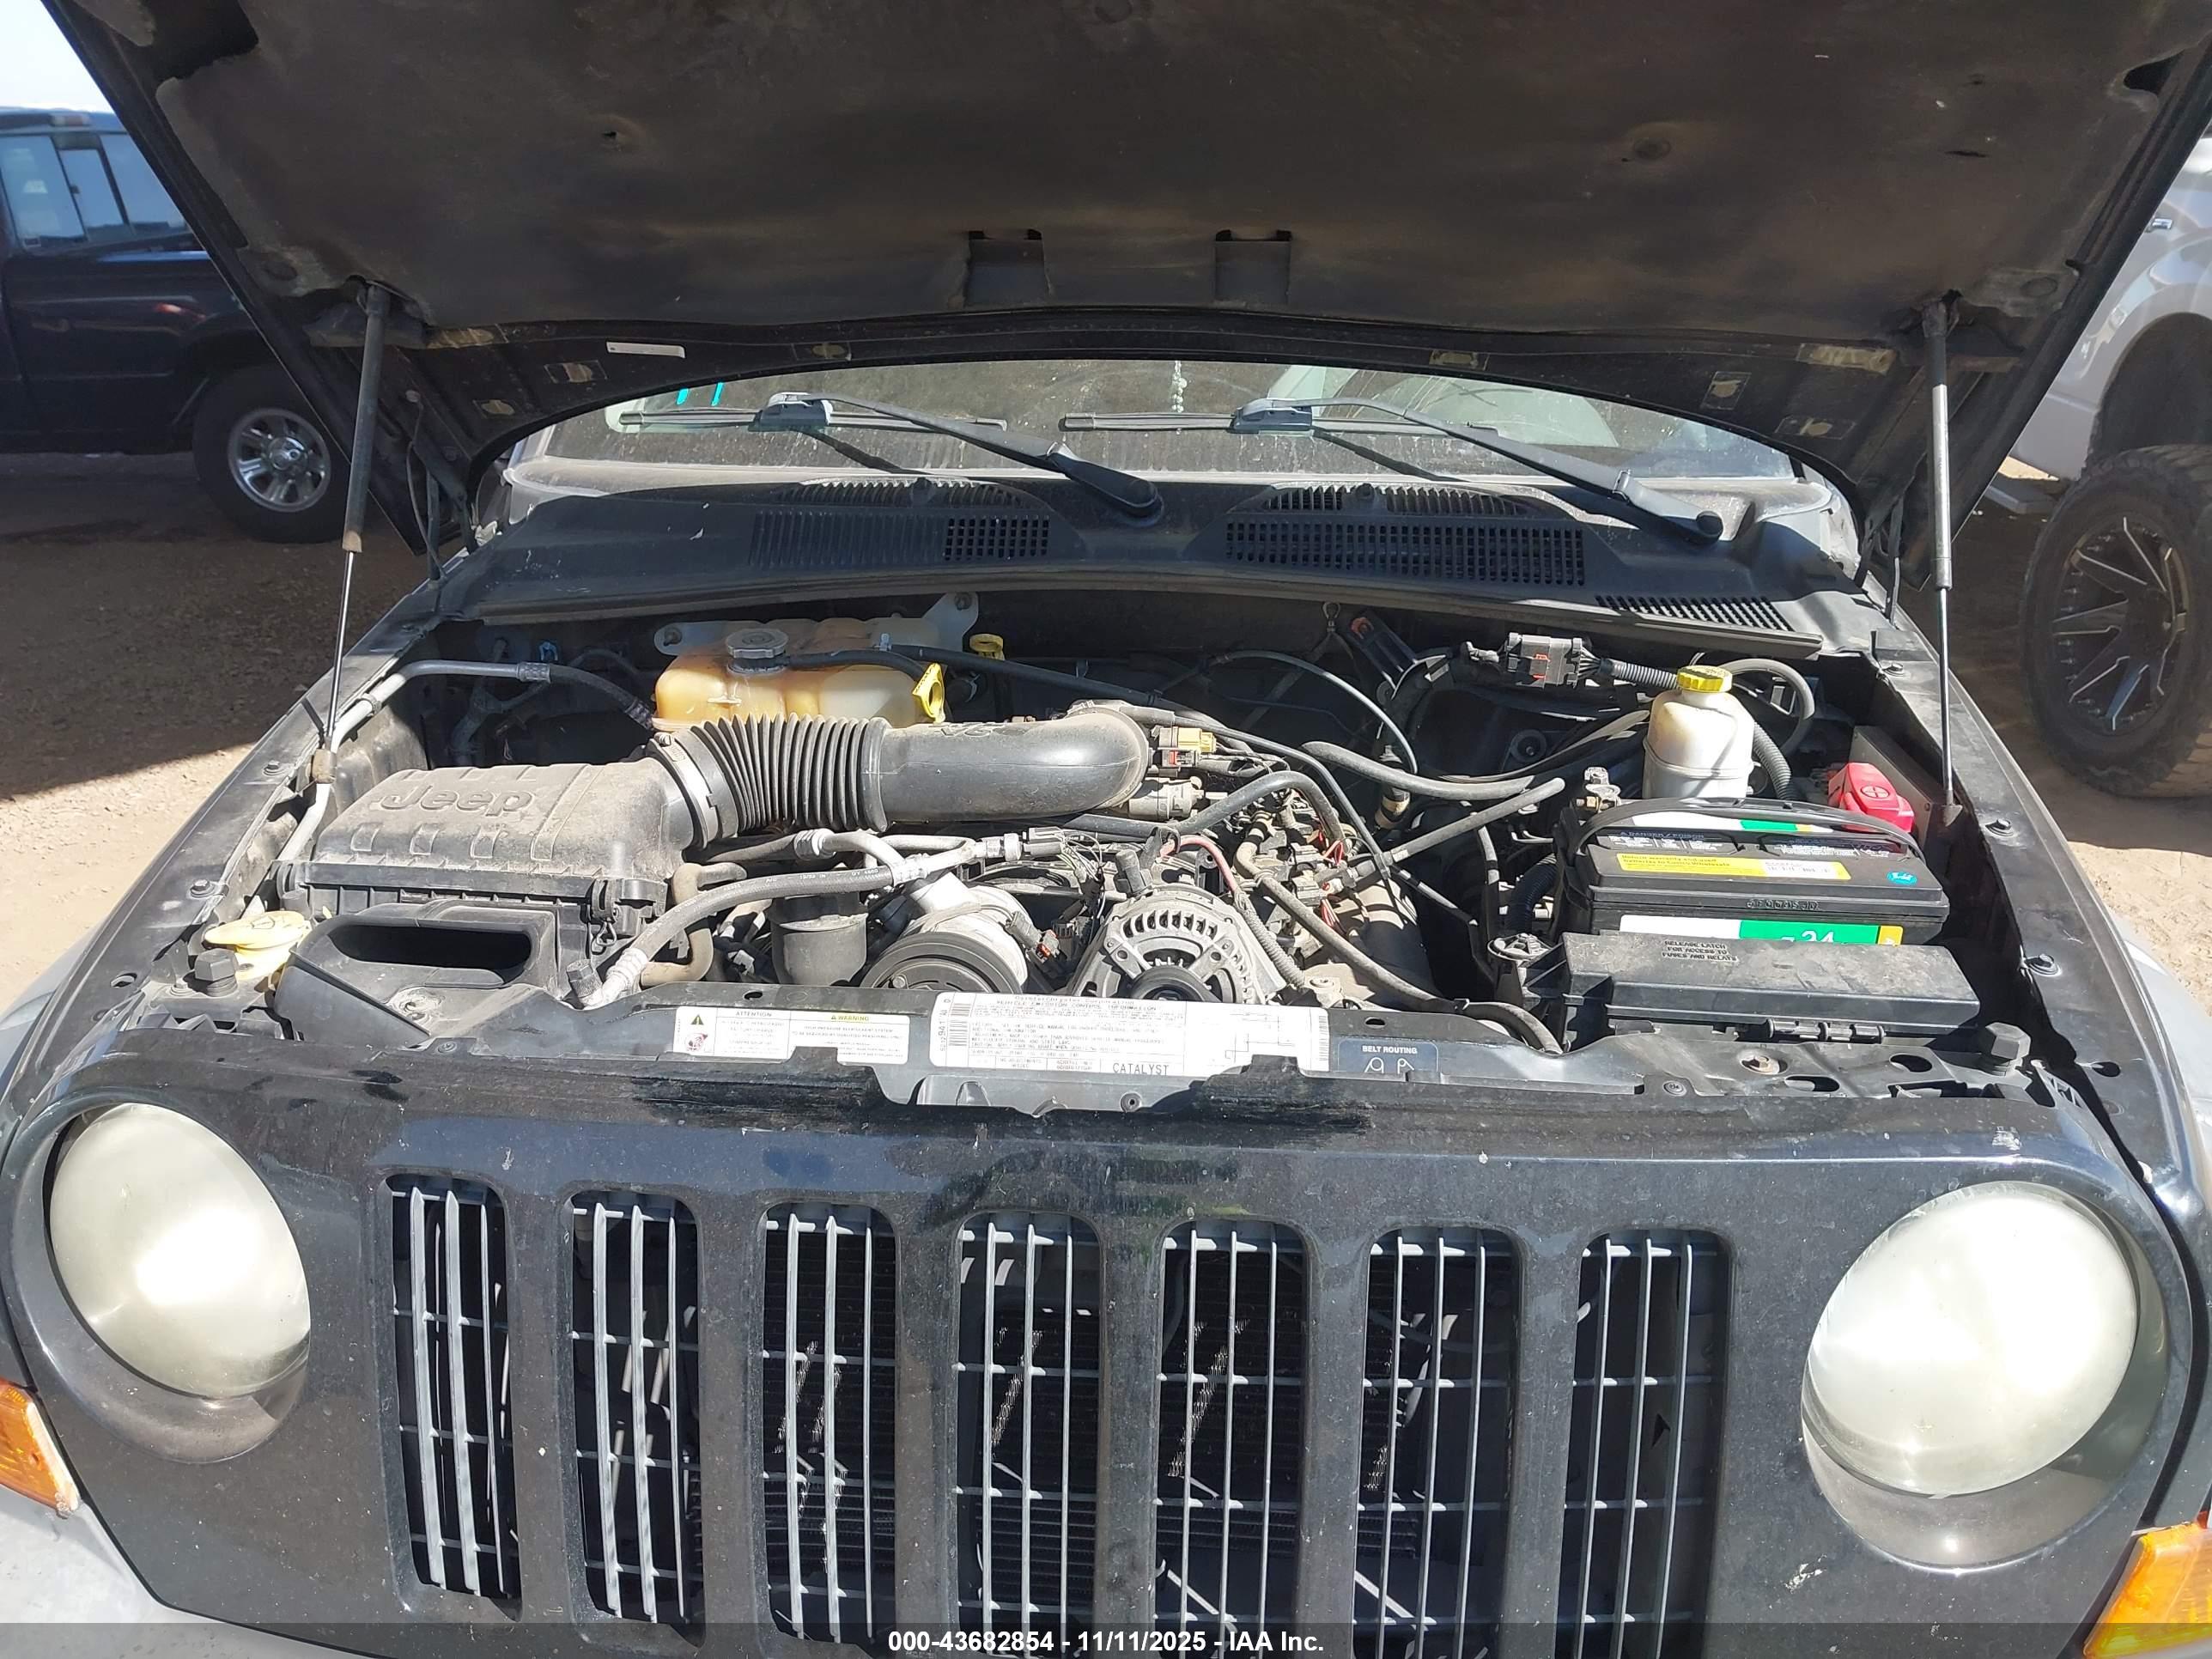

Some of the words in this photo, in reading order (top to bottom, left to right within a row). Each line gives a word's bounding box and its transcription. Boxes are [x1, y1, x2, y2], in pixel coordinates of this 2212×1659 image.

[380, 783, 534, 817] Jeep
[1362, 1045, 1382, 1054] BELT
[1383, 1046, 1418, 1054] ROUTING
[1112, 1061, 1170, 1076] CATALYST
